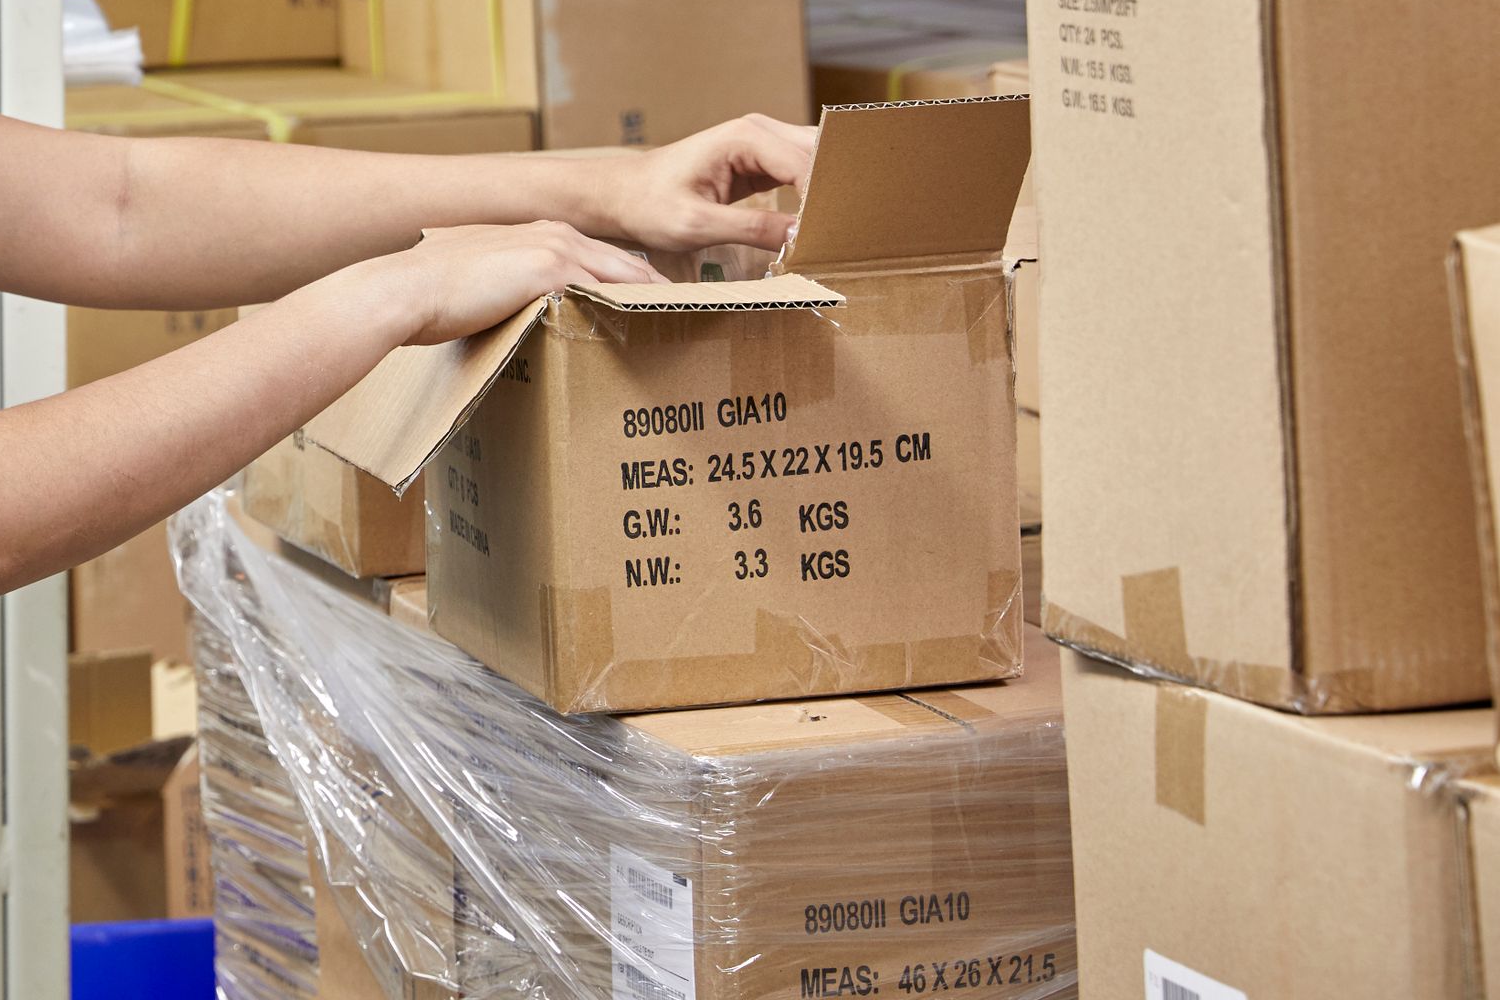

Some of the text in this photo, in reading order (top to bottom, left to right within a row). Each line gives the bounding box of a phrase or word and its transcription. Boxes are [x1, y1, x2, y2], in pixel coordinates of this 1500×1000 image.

[1084, 26, 1097, 46] 24
[717, 391, 787, 428] GIA10
[620, 432, 931, 491] MEAS: 24.5 X 22 X 19.5 CM
[623, 499, 850, 541] G.W.: 3.6 KGS
[625, 548, 851, 588] N.W.: 3.3 KGS
[899, 891, 970, 926] GIA10
[800, 953, 1057, 999] MEAS: 46 X 26 X 21.5
